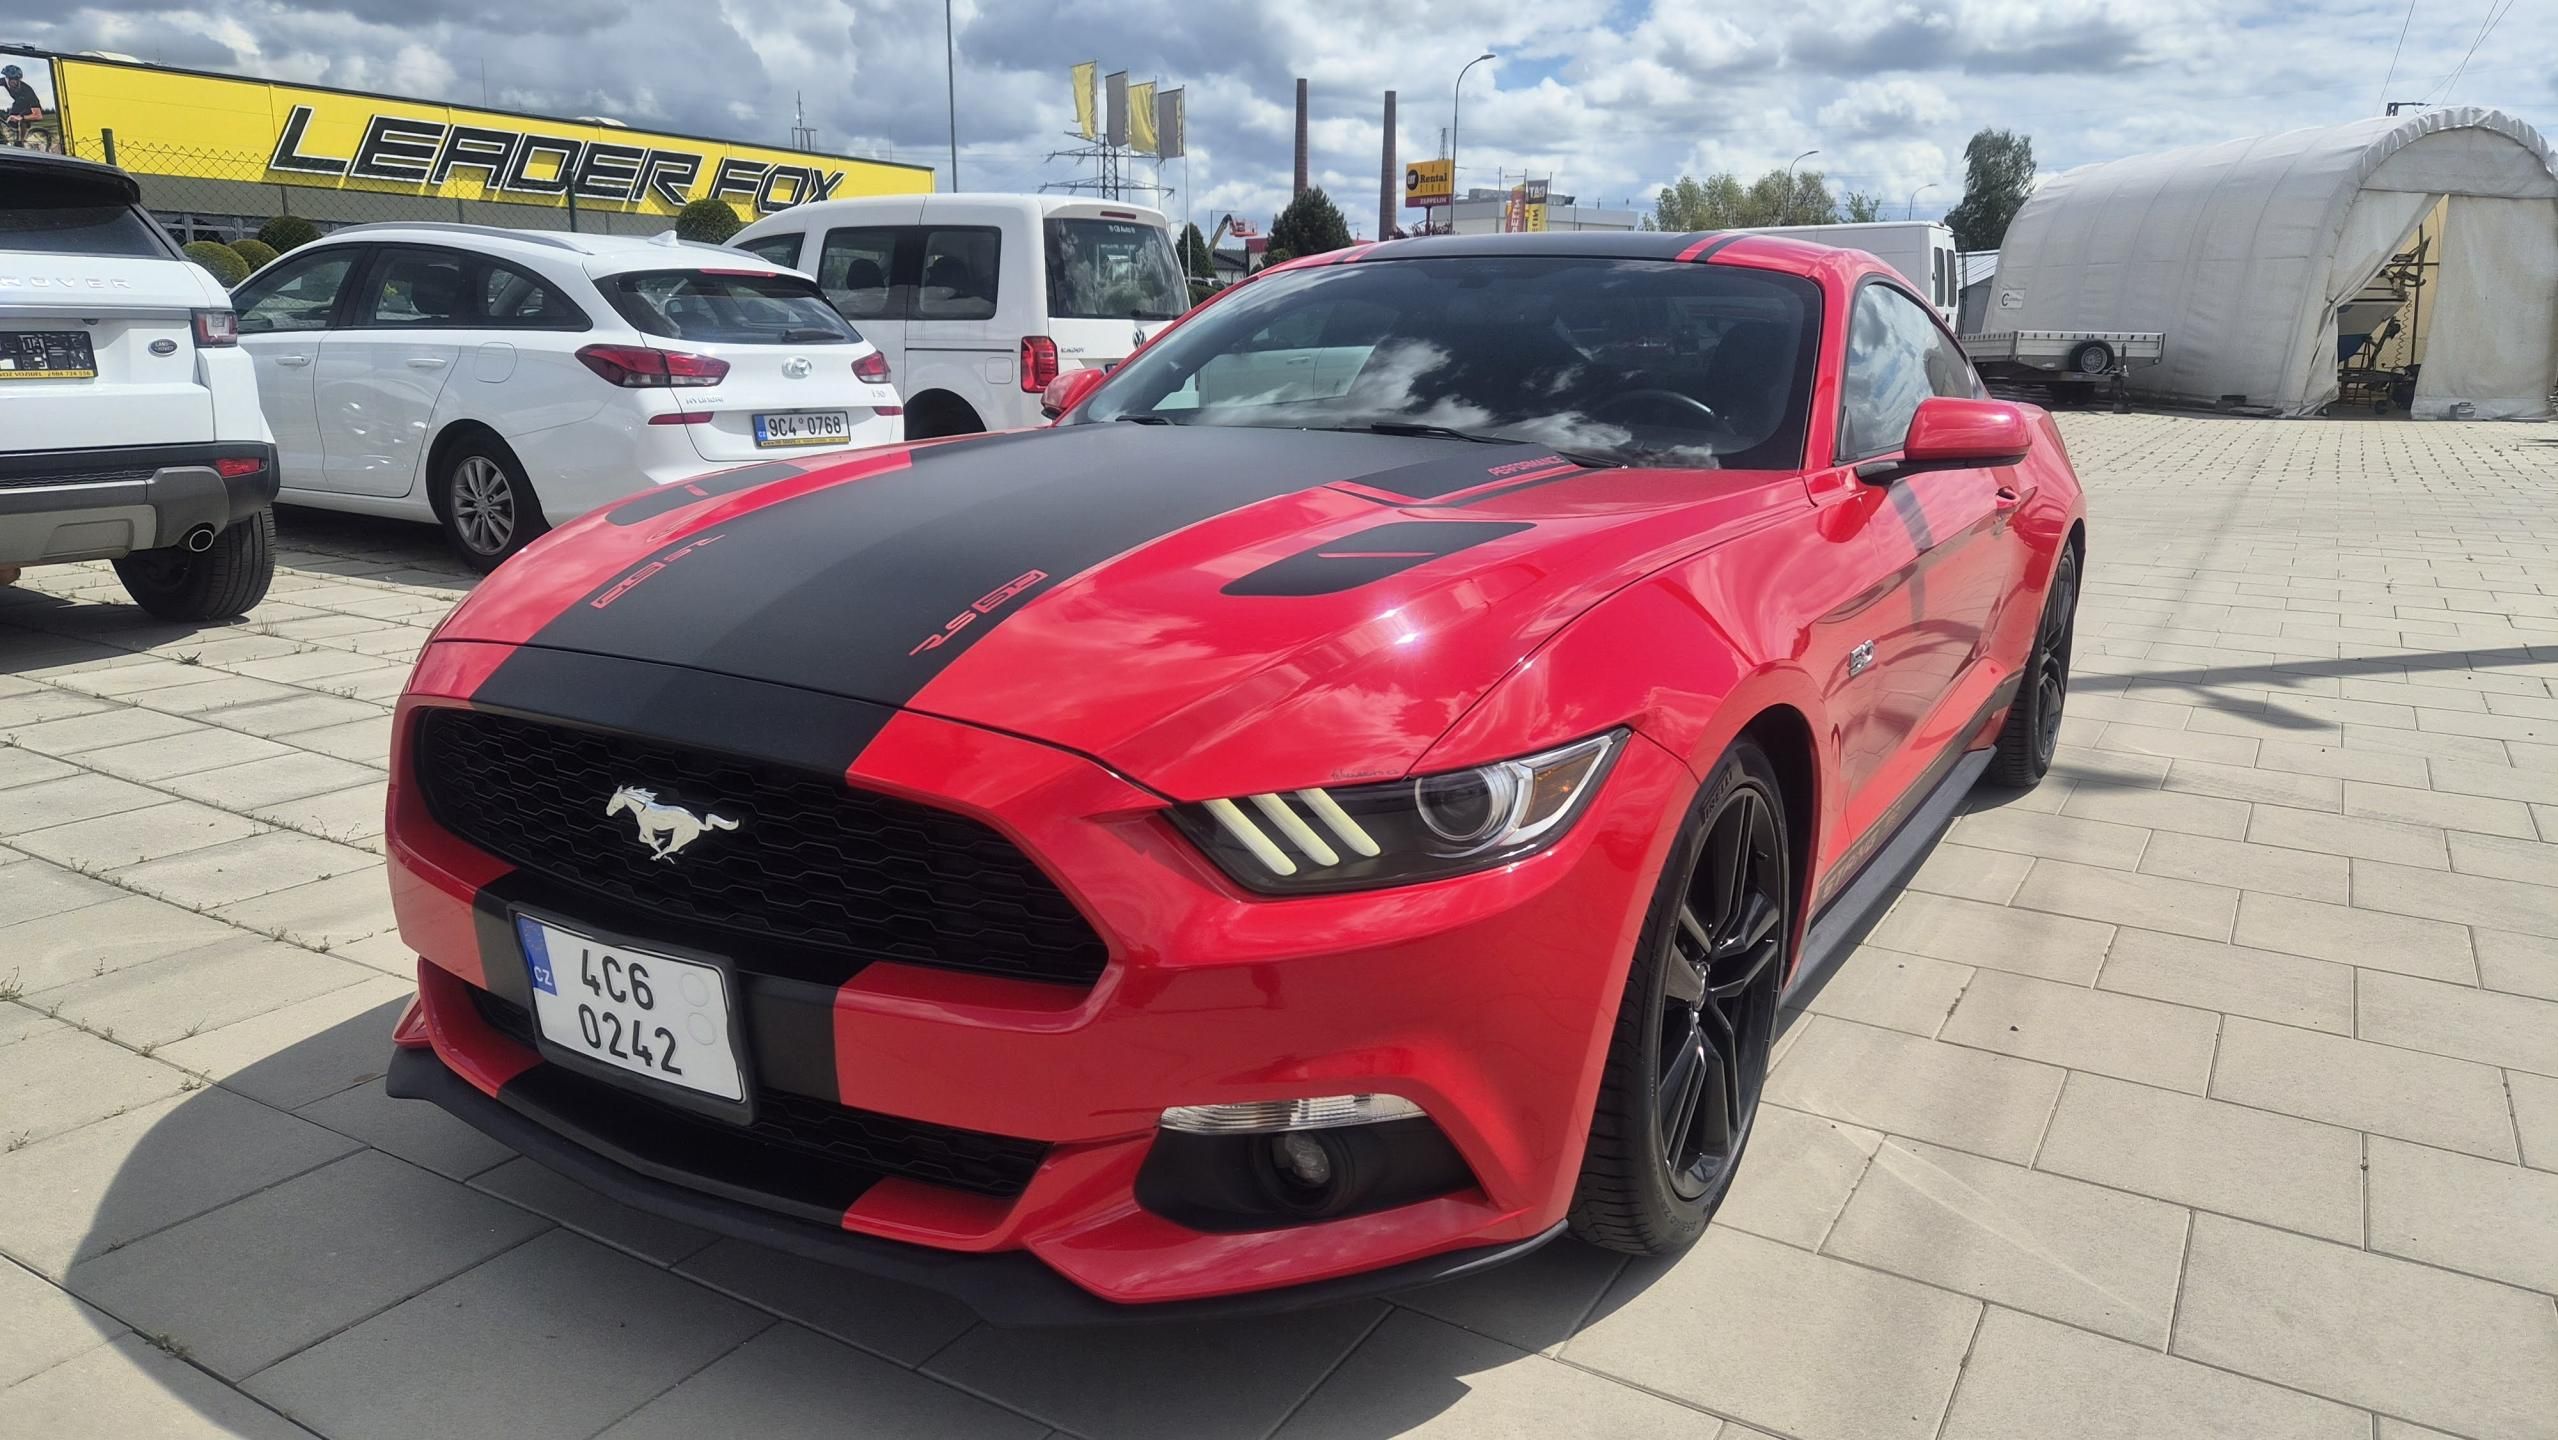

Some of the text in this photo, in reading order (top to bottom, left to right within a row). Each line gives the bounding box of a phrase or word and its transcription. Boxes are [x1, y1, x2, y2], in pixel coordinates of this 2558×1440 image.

[268, 103, 848, 214] LEADER FOX
[1420, 172, 1448, 184] Rental
[768, 416, 842, 437] 9C4 0768
[533, 965, 553, 987] CZ
[580, 948, 654, 1011] 4C6
[577, 1003, 683, 1076] 0242
